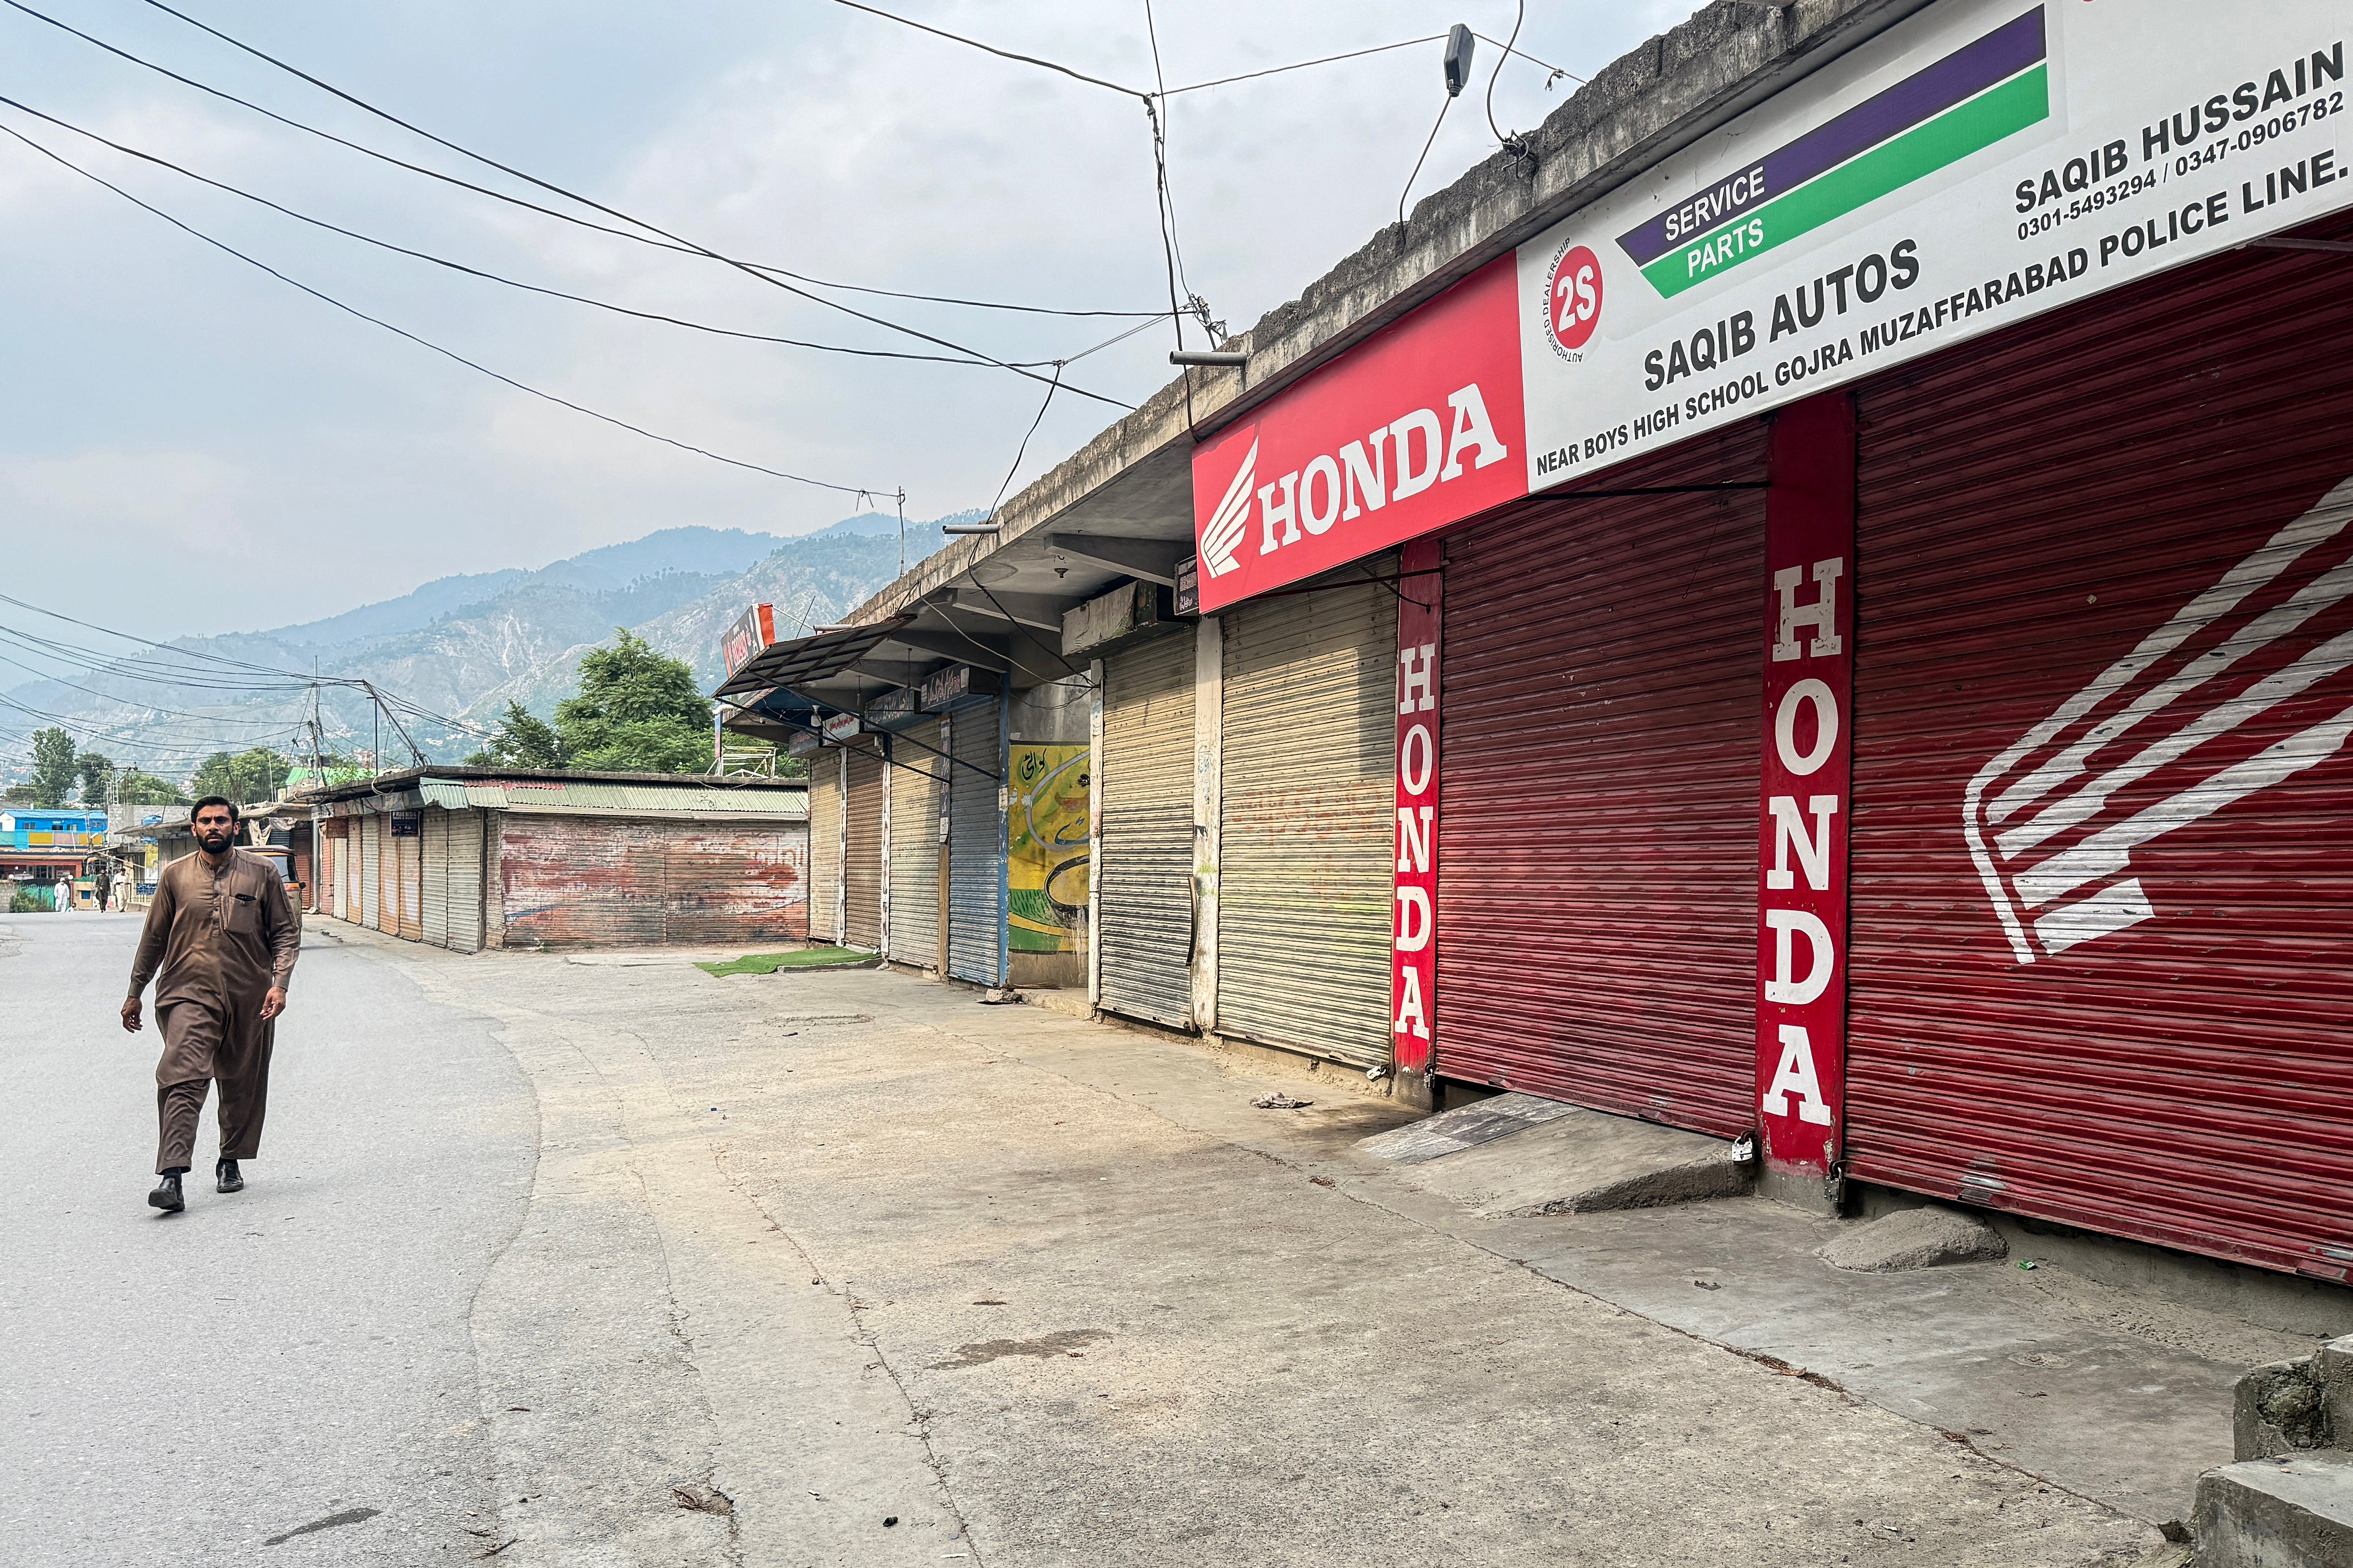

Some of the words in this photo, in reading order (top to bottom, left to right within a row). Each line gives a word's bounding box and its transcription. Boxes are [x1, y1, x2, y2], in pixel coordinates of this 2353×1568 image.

[2016, 139, 2128, 213] SAQIB
[2142, 40, 2344, 162] HUSSAIN
[2018, 169, 2156, 240] 0301-5493294
[2176, 91, 2344, 176] 0347-0906782
[1543, 237, 1570, 316] DEALERSHIP
[1666, 166, 1765, 241] SERVICE
[1687, 218, 1764, 278] PARTS
[1537, 443, 1580, 476] NEAR
[1584, 424, 1628, 460] BOYS
[1634, 403, 1679, 440] HIGH
[1685, 371, 1769, 420] SCHOOL
[1775, 338, 1853, 386] GOJRA
[1860, 248, 2088, 356] MUZAFFARABAD
[2099, 191, 2229, 267] POLICE
[2242, 148, 2348, 214] LINE.
[1544, 319, 1583, 363] AUTHORISED
[1557, 264, 1596, 333] 2S
[1645, 310, 1756, 391] SAQIB
[1769, 239, 1919, 343] AUTOS
[1257, 382, 1507, 556] HONDA
[1394, 641, 1436, 1041] HONDA
[1763, 557, 1843, 1126] HONDA
